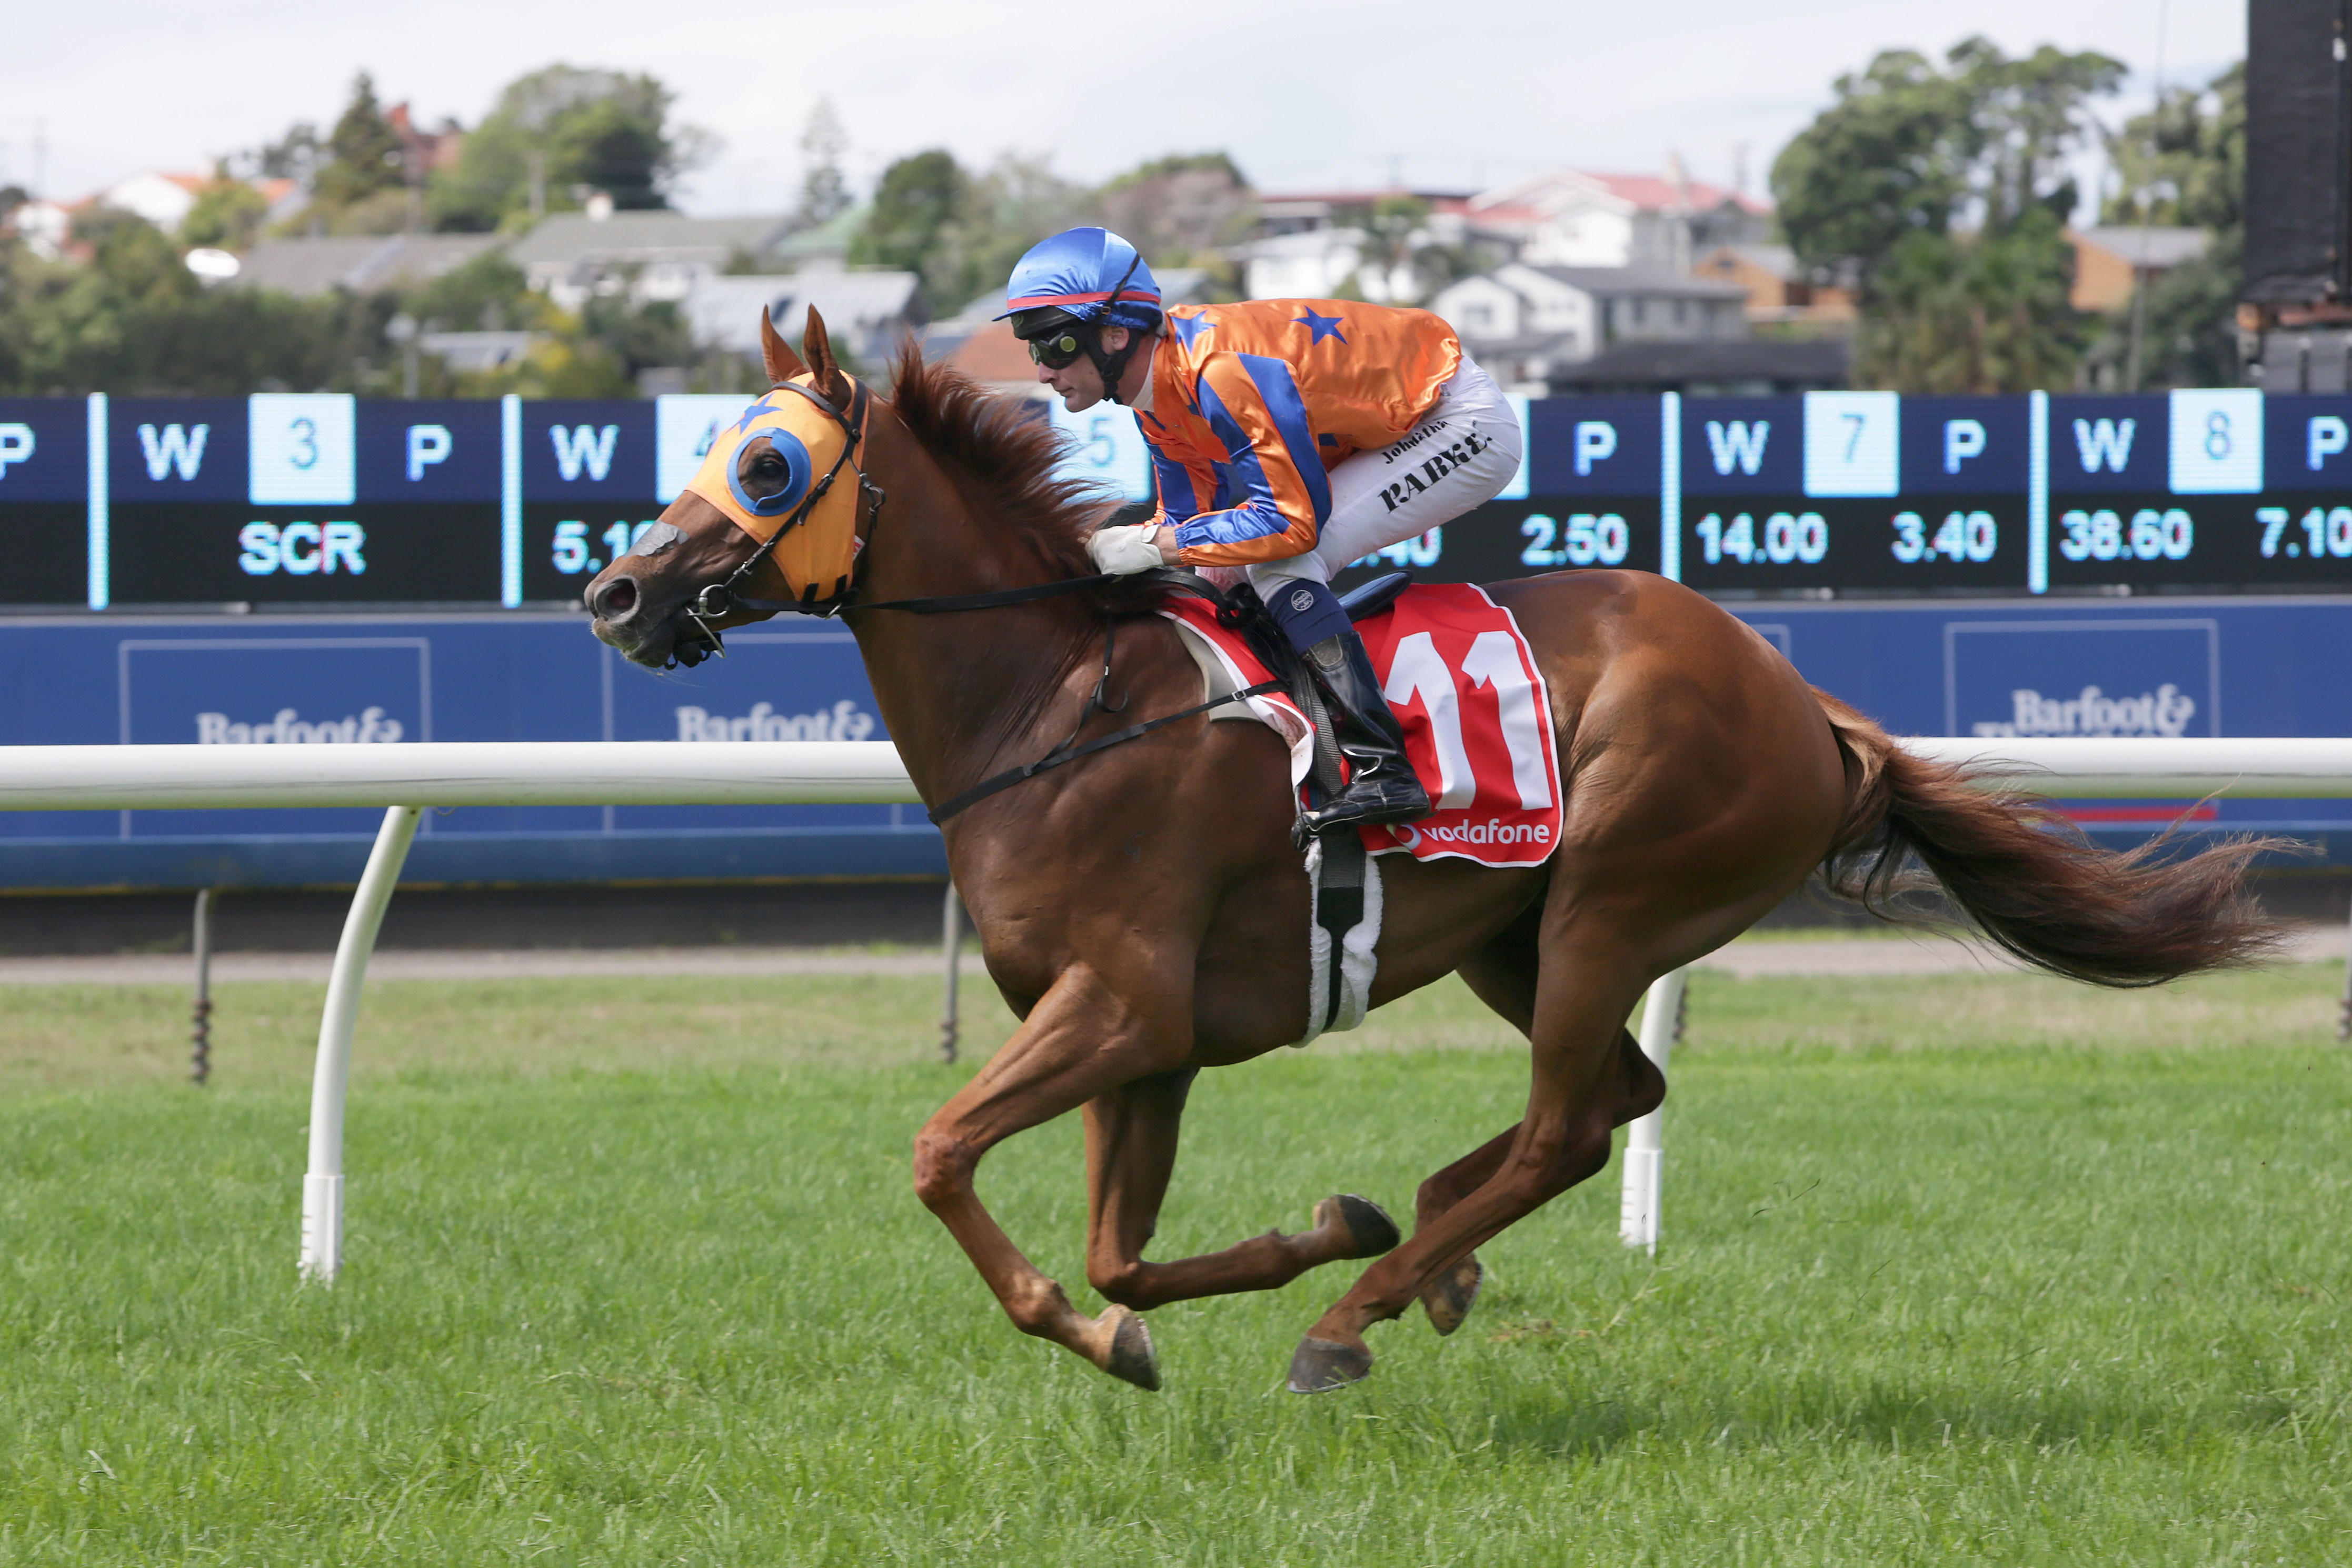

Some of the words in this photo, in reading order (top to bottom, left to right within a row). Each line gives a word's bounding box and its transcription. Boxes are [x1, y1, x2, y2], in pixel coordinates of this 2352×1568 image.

[0, 422, 36, 480] P
[137, 423, 210, 481] W
[288, 417, 320, 471] 3
[405, 424, 453, 481] P
[549, 424, 620, 482] W
[1088, 417, 1117, 467] 5
[1378, 420, 1492, 514] PARKE
[1573, 421, 1618, 476] P
[1705, 420, 1771, 475] W
[1840, 413, 1867, 464] 7
[1942, 419, 1987, 474] P
[2072, 418, 2137, 473] W
[2205, 411, 2233, 460] 8
[2306, 416, 2349, 471] P
[238, 521, 366, 575] SCR
[1346, 526, 1442, 567] .40
[1521, 513, 1630, 566] 2.50
[1696, 512, 1829, 564] 14.00
[1891, 511, 1998, 563] 3.40
[2059, 508, 2194, 561] 38.60
[2255, 506, 2352, 558] 7.10
[1385, 631, 1553, 811] 11
[1421, 818, 1550, 844] vodafone
